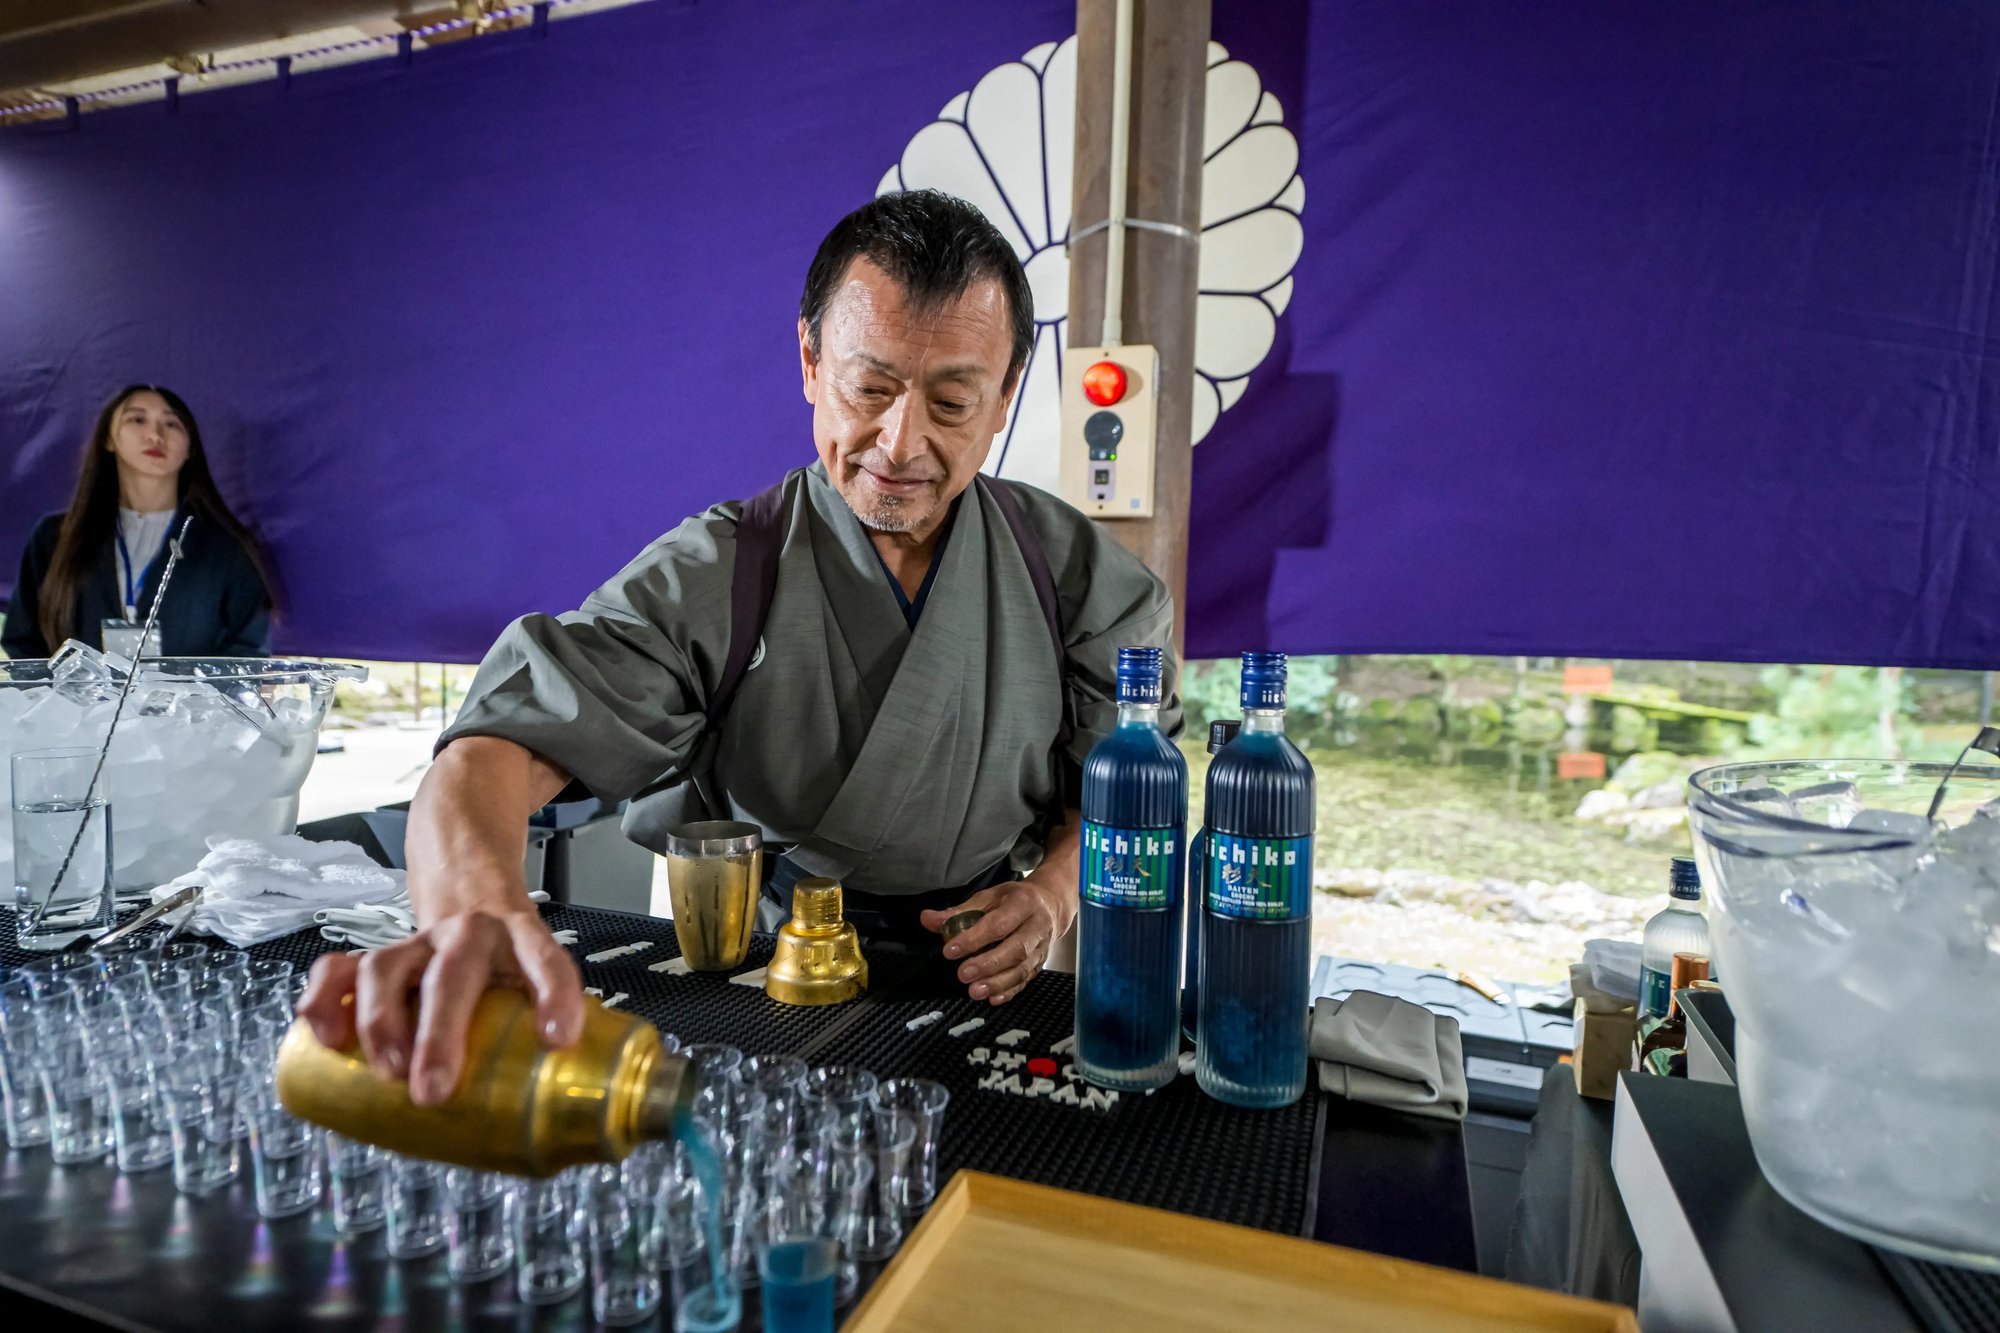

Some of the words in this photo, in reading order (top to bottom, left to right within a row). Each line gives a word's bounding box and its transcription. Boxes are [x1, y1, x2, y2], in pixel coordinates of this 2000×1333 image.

[1085, 828, 1174, 855] iichiko
[1205, 836, 1296, 866] iichiko
[1110, 875, 1141, 884] BAITEN
[1227, 884, 1259, 894] BAITEN
[977, 1069, 1119, 1113] JAPAN
